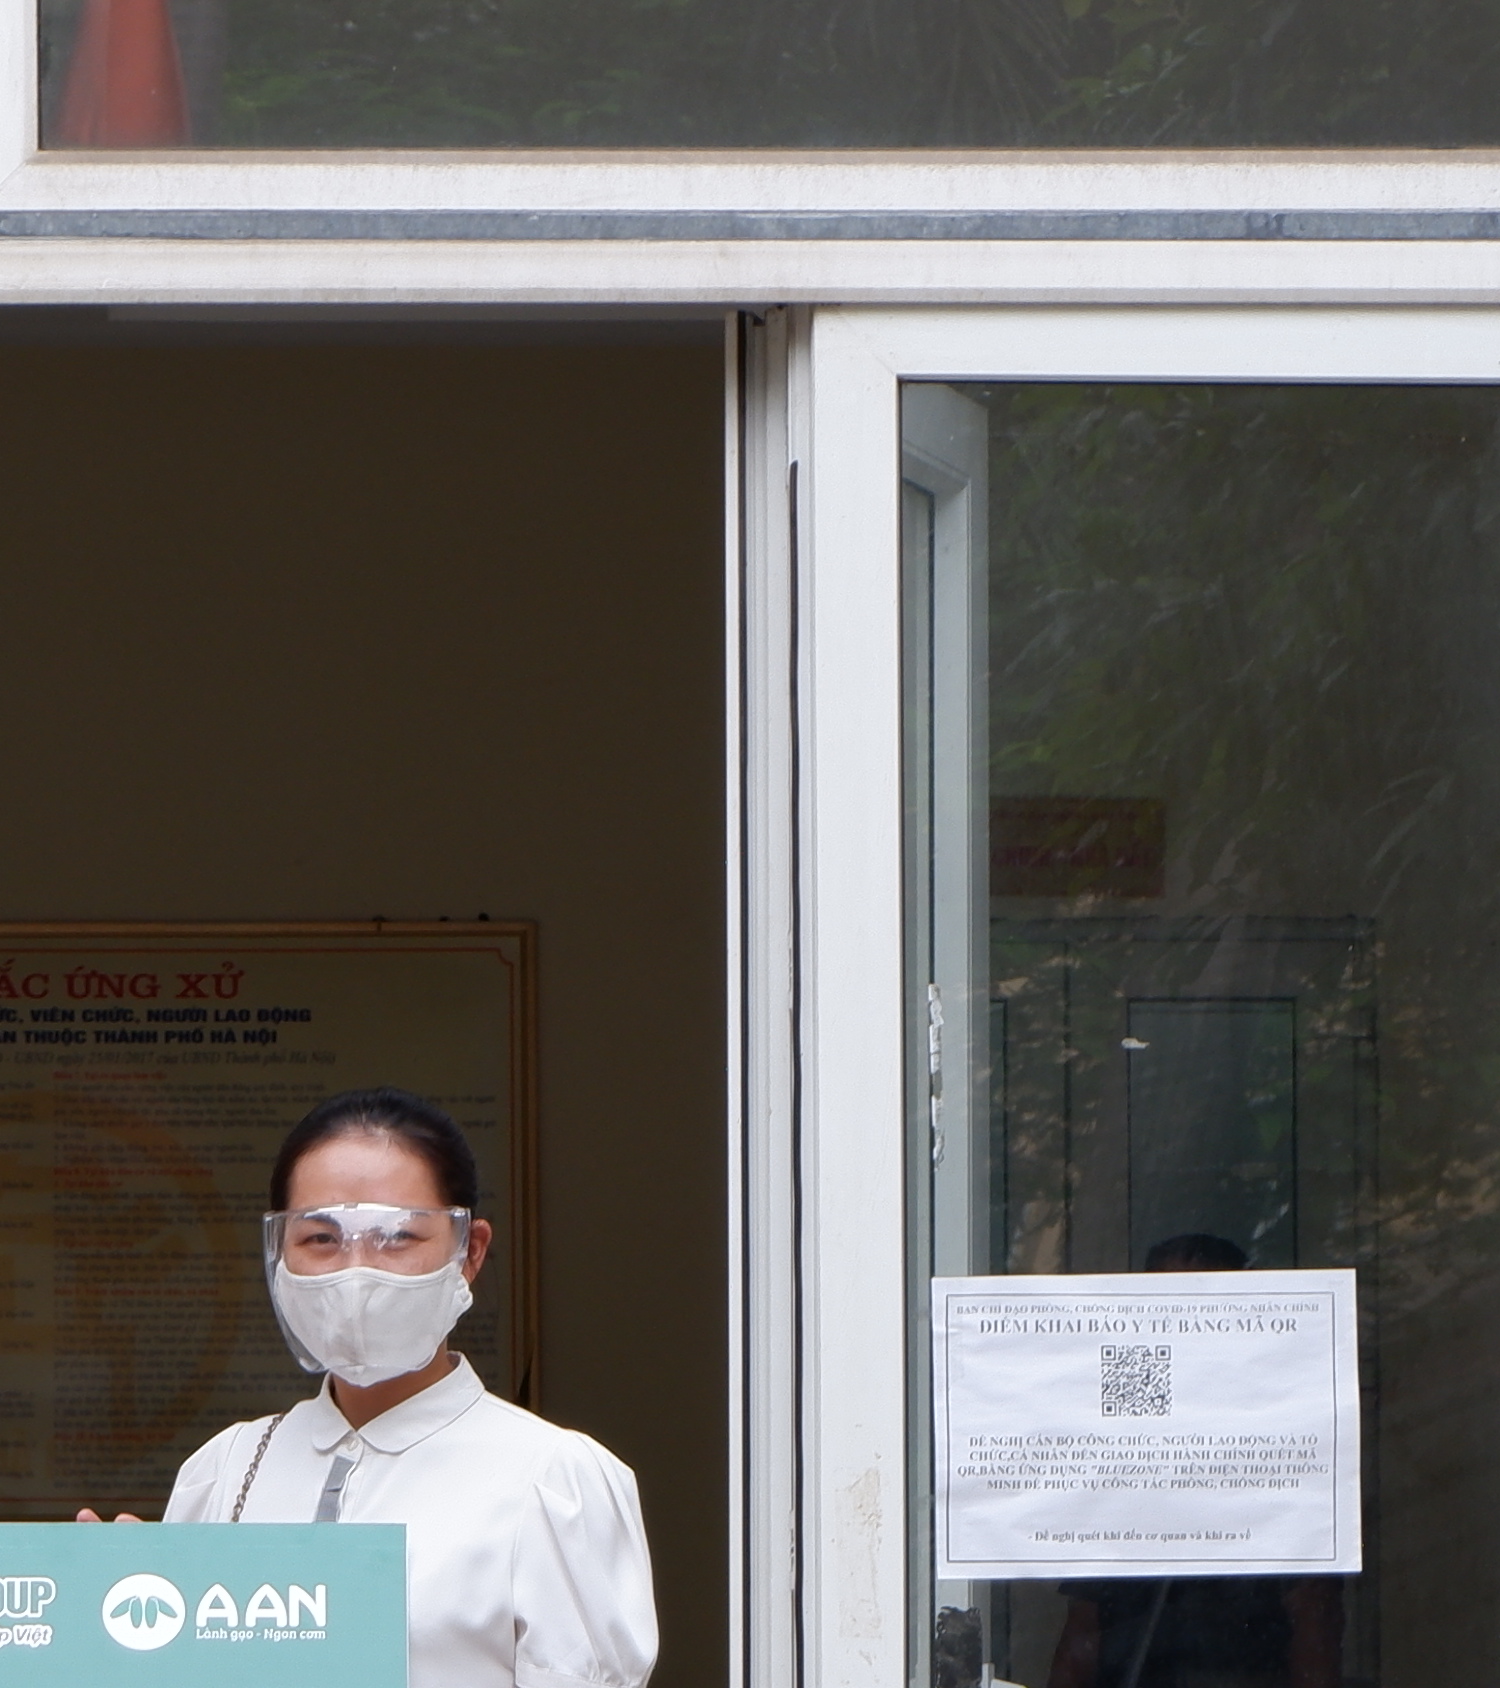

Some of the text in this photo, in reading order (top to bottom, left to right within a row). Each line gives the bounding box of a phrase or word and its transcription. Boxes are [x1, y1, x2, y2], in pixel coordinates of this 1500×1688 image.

[1132, 1319, 1144, 1333] Y
[1270, 1318, 1297, 1334] QR
[13, 1627, 52, 1647] Việt
[264, 1629, 297, 1642] Ngon
